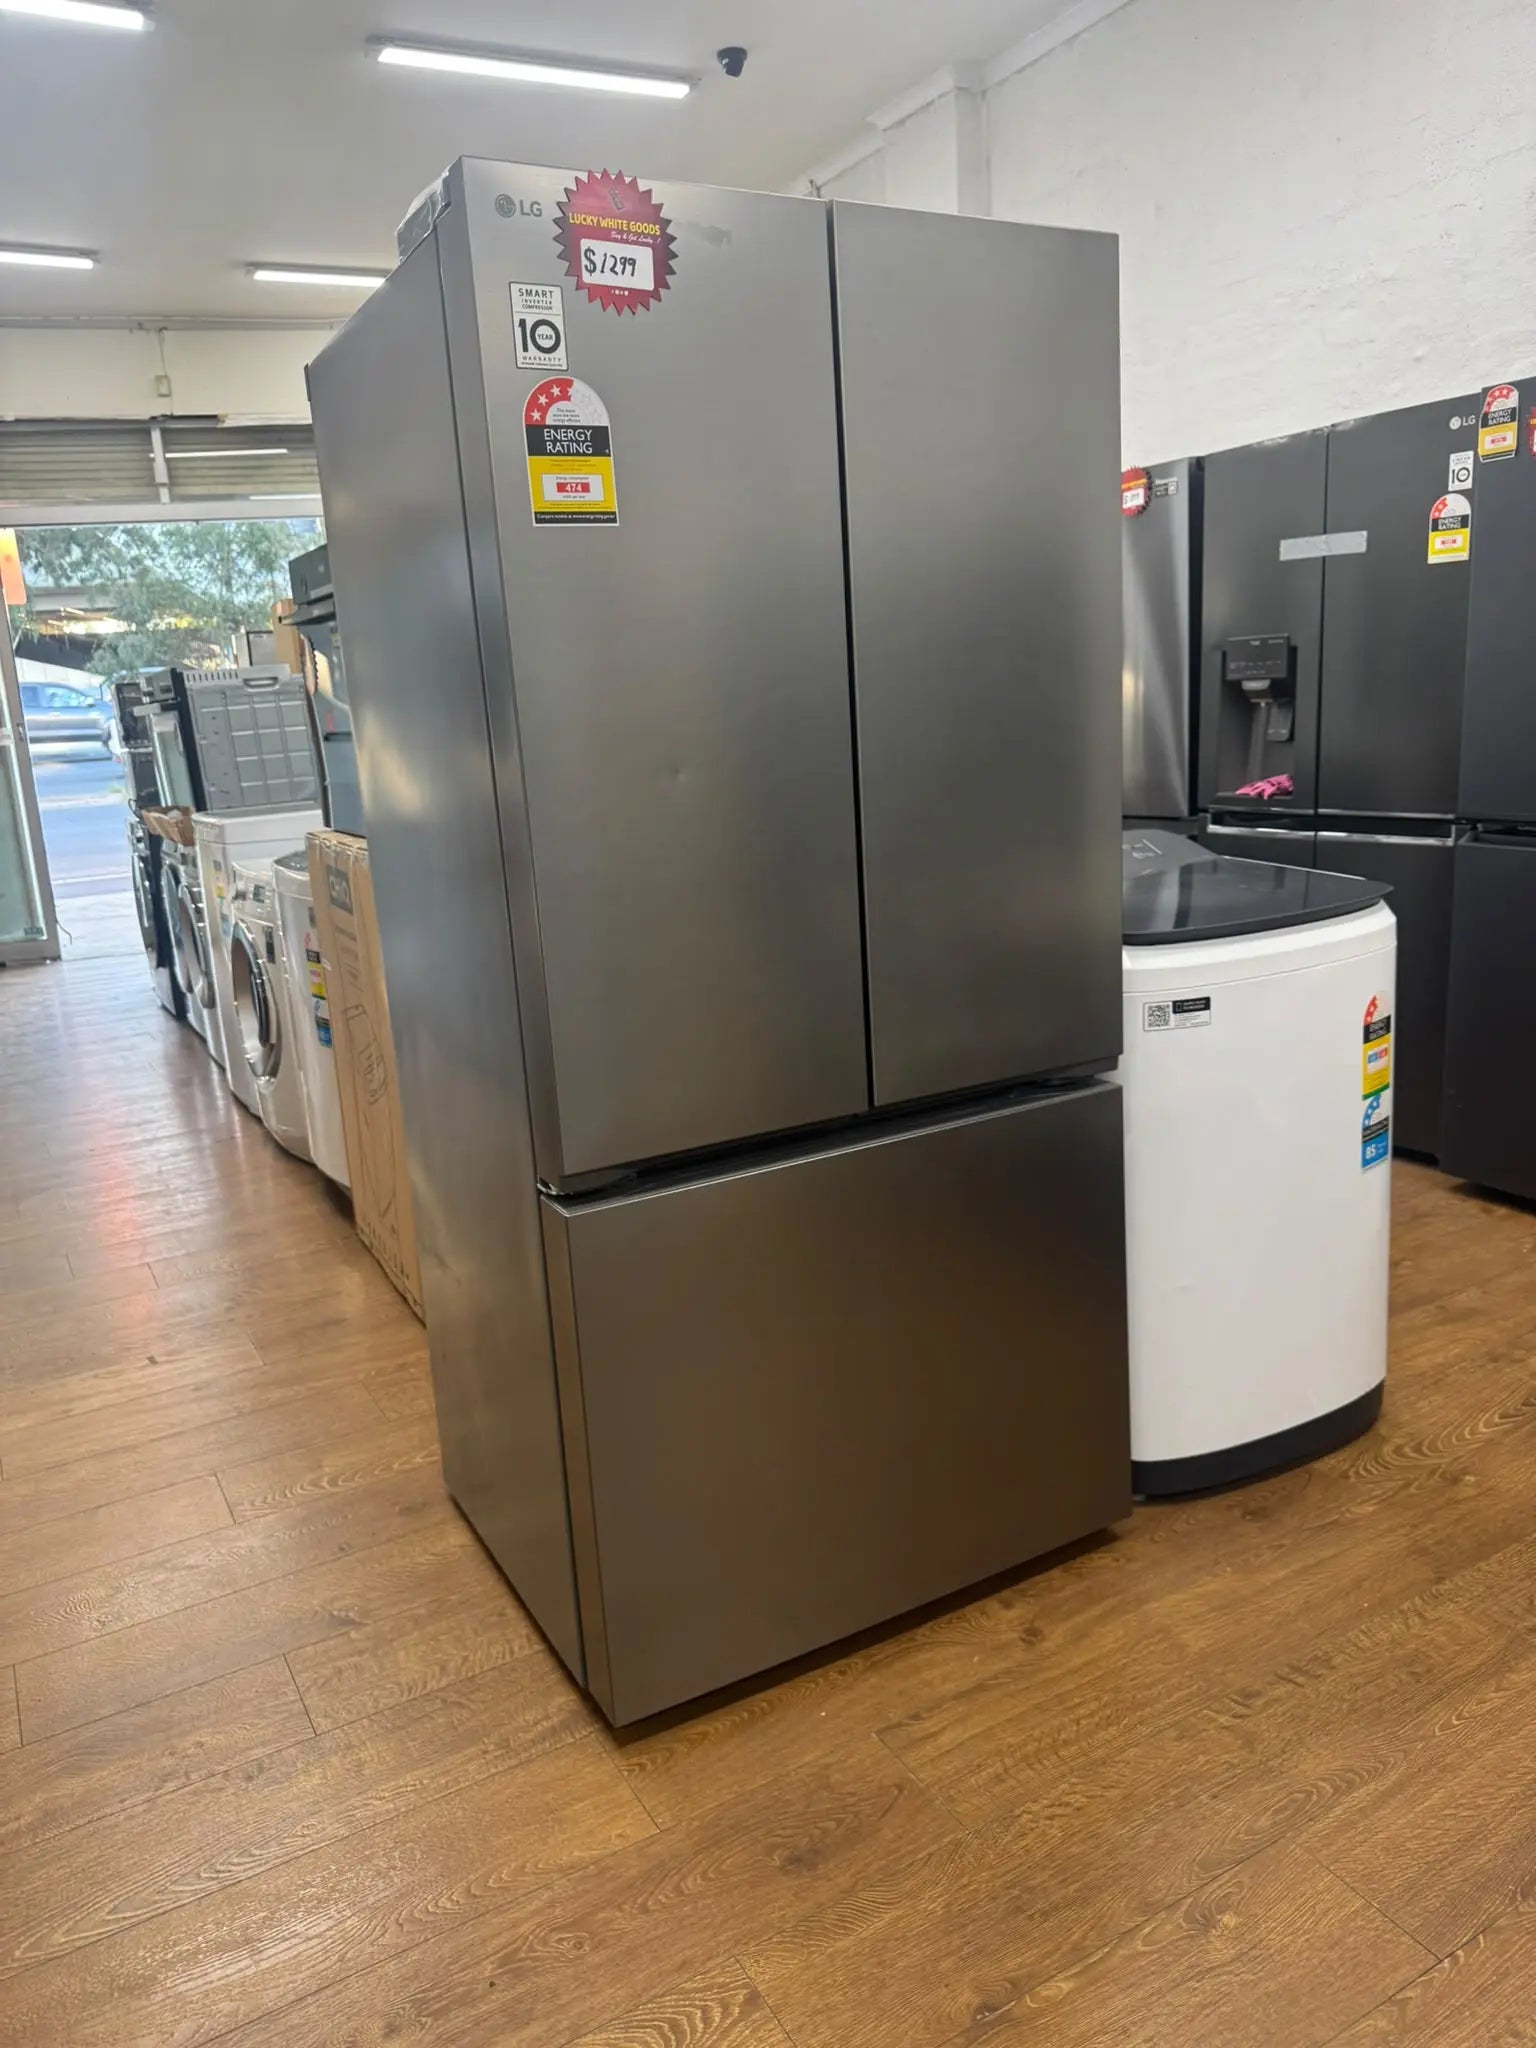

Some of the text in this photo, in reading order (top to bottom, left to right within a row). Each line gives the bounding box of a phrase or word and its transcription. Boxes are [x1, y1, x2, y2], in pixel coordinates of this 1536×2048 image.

[520, 199, 542, 217] LG
[569, 212, 661, 235] LUCKY WHITE GOODS
[583, 247, 637, 277] $1299
[518, 288, 554, 299] SMART
[518, 318, 561, 354] 10
[537, 333, 553, 341] YEAR
[1488, 409, 1512, 418] ENERGY
[1462, 415, 1476, 426] LG
[1488, 416, 1511, 425] RATING
[544, 428, 592, 441] ENERGY
[546, 442, 592, 454] RATING
[565, 483, 582, 492] 474
